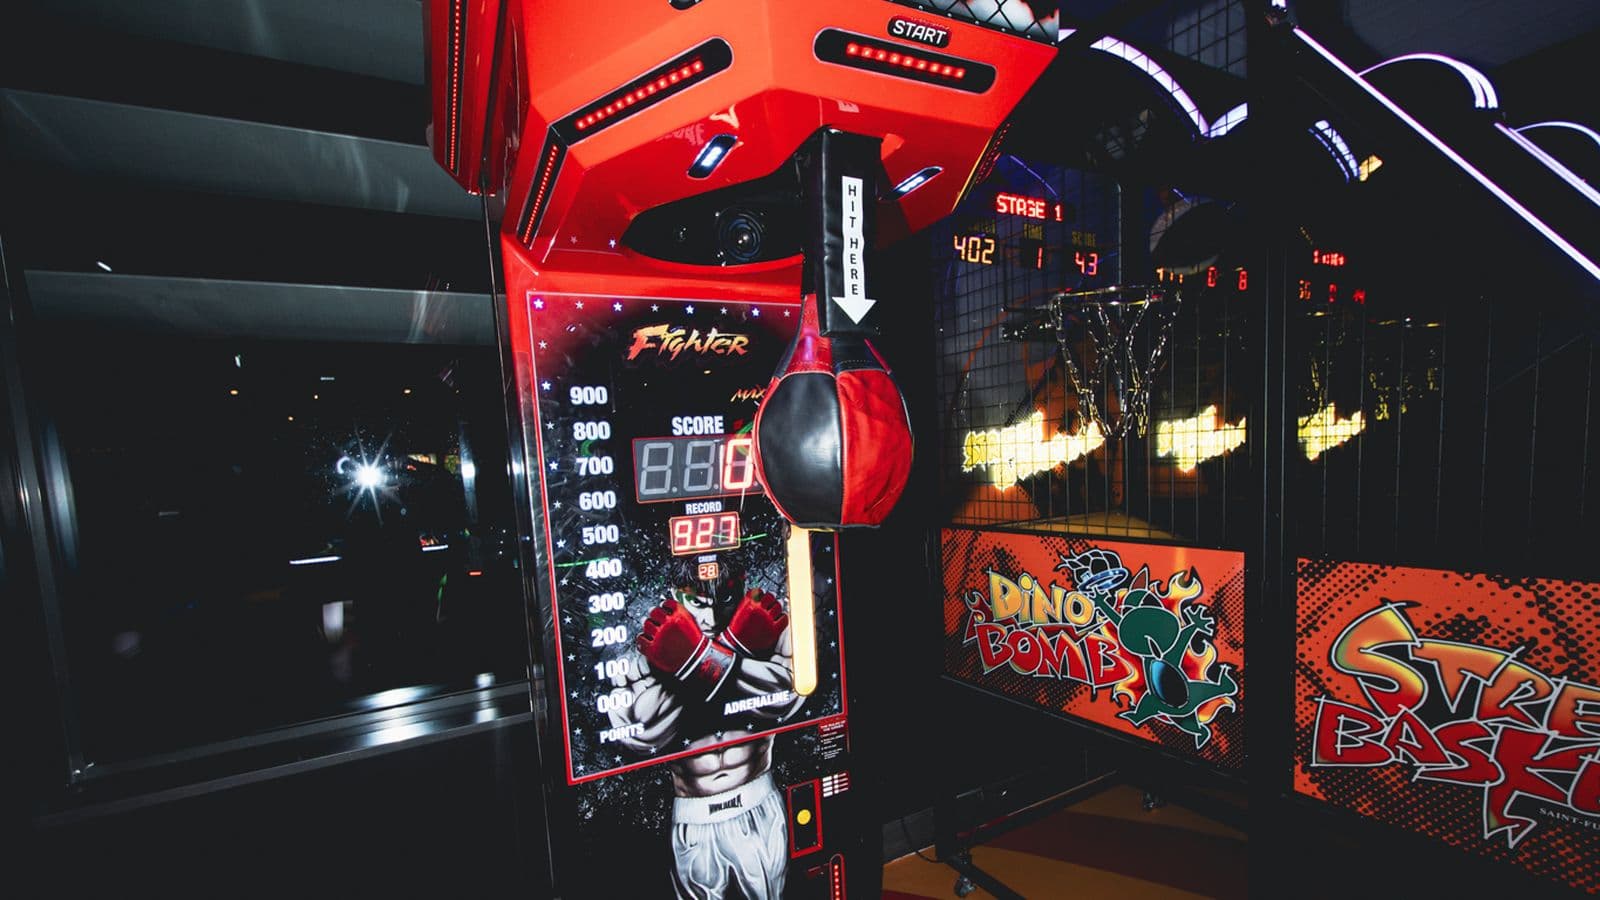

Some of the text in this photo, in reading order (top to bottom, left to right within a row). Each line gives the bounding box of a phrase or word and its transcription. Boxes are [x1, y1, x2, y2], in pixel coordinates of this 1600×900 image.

[893, 19, 947, 44] START
[996, 194, 1063, 221] STAGE 1
[848, 184, 859, 296] HIT HERE
[953, 234, 995, 264] 402
[1036, 247, 1043, 269] 1
[1075, 251, 1098, 275] 43
[569, 386, 608, 405] 900
[573, 421, 611, 441] 800
[671, 415, 725, 436] SCORE
[576, 456, 614, 476] 700
[579, 490, 616, 510] 600
[685, 501, 722, 515] RECORD
[582, 525, 619, 545] 500
[673, 515, 737, 552] 927
[585, 558, 622, 579] 400
[588, 592, 625, 614] 300
[591, 625, 628, 647] 200
[594, 658, 629, 680] 100
[974, 622, 1136, 694] BOMB
[597, 690, 633, 713] 000
[723, 690, 790, 716] ADRENALINE
[600, 722, 646, 743] POINTS
